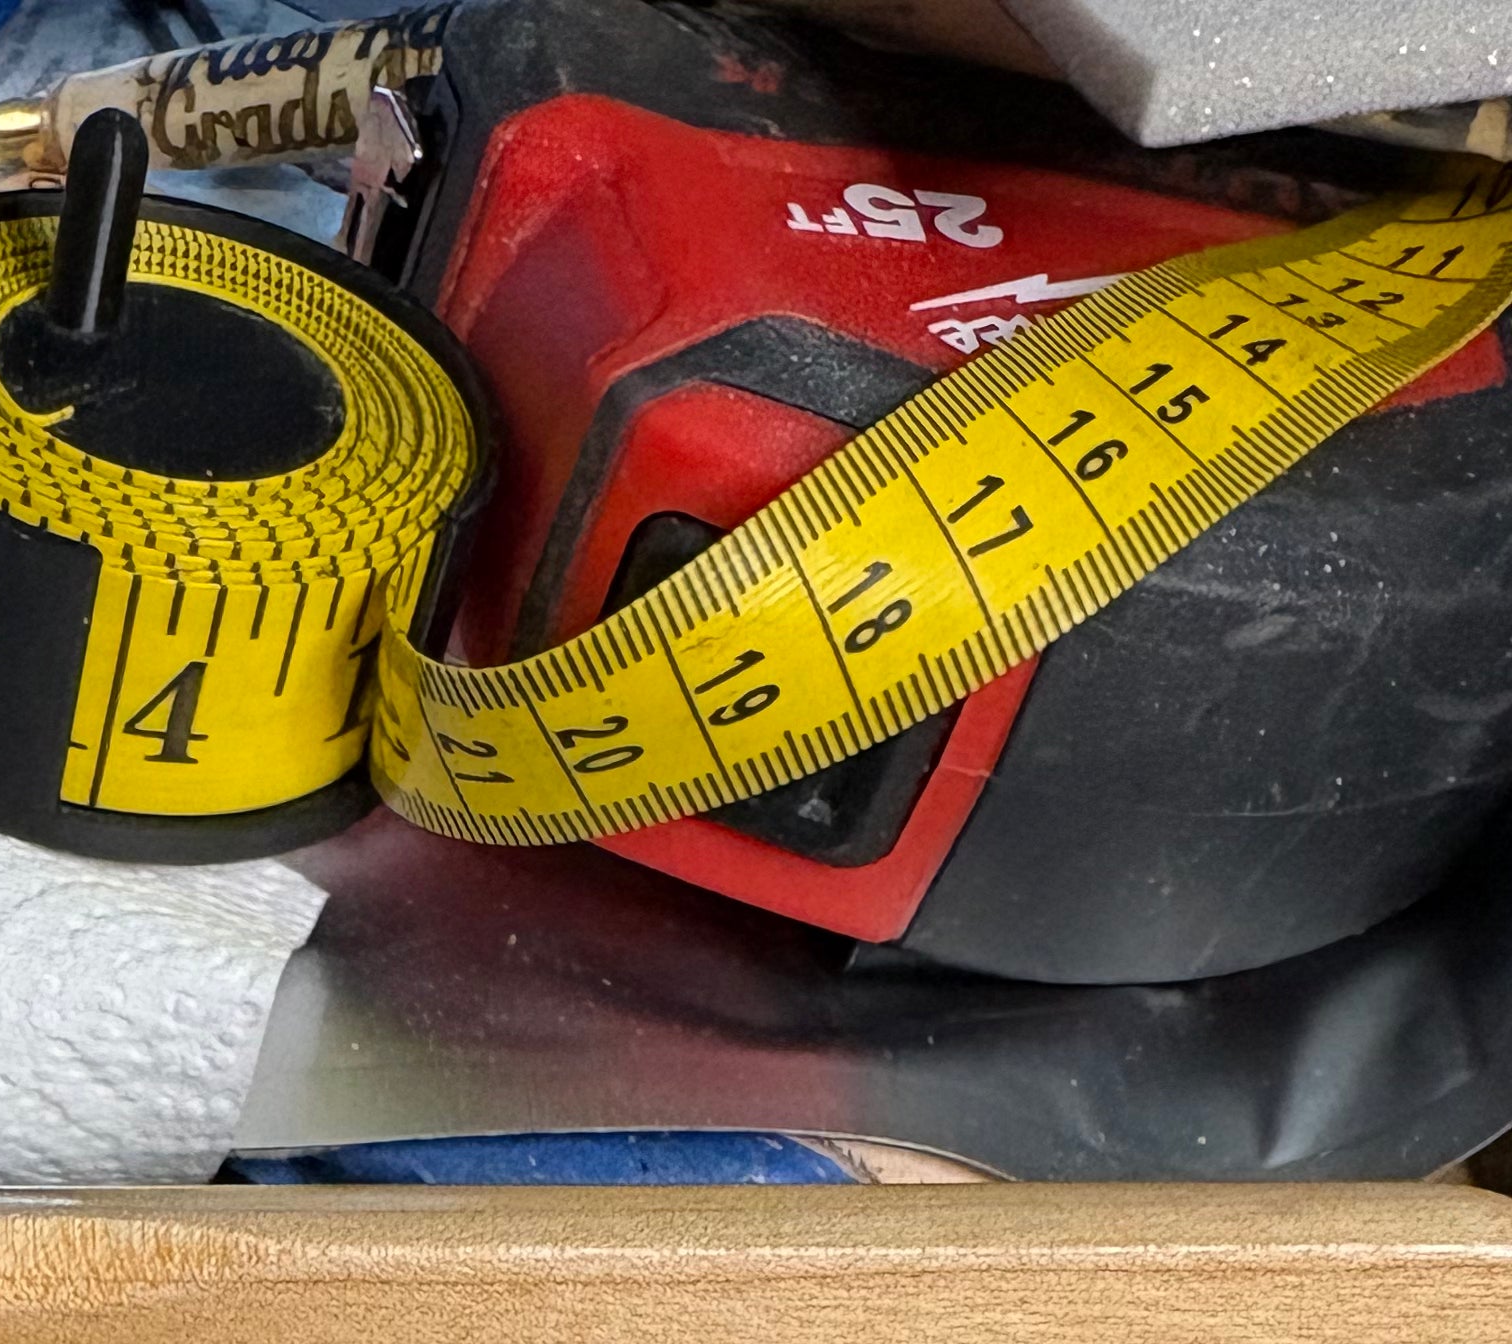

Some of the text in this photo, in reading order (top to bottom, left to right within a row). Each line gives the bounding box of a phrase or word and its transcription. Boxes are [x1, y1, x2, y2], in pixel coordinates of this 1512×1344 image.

[1388, 245, 1466, 277] 11
[1274, 292, 1348, 329] 13
[1328, 277, 1405, 312] 12
[1208, 314, 1288, 367] 14
[1128, 362, 1210, 425] 15
[1046, 408, 1130, 482] 16
[946, 474, 1035, 558] 17
[826, 560, 913, 654] 18
[693, 648, 781, 726] 19
[436, 731, 516, 784] 21
[551, 715, 645, 774] 20
